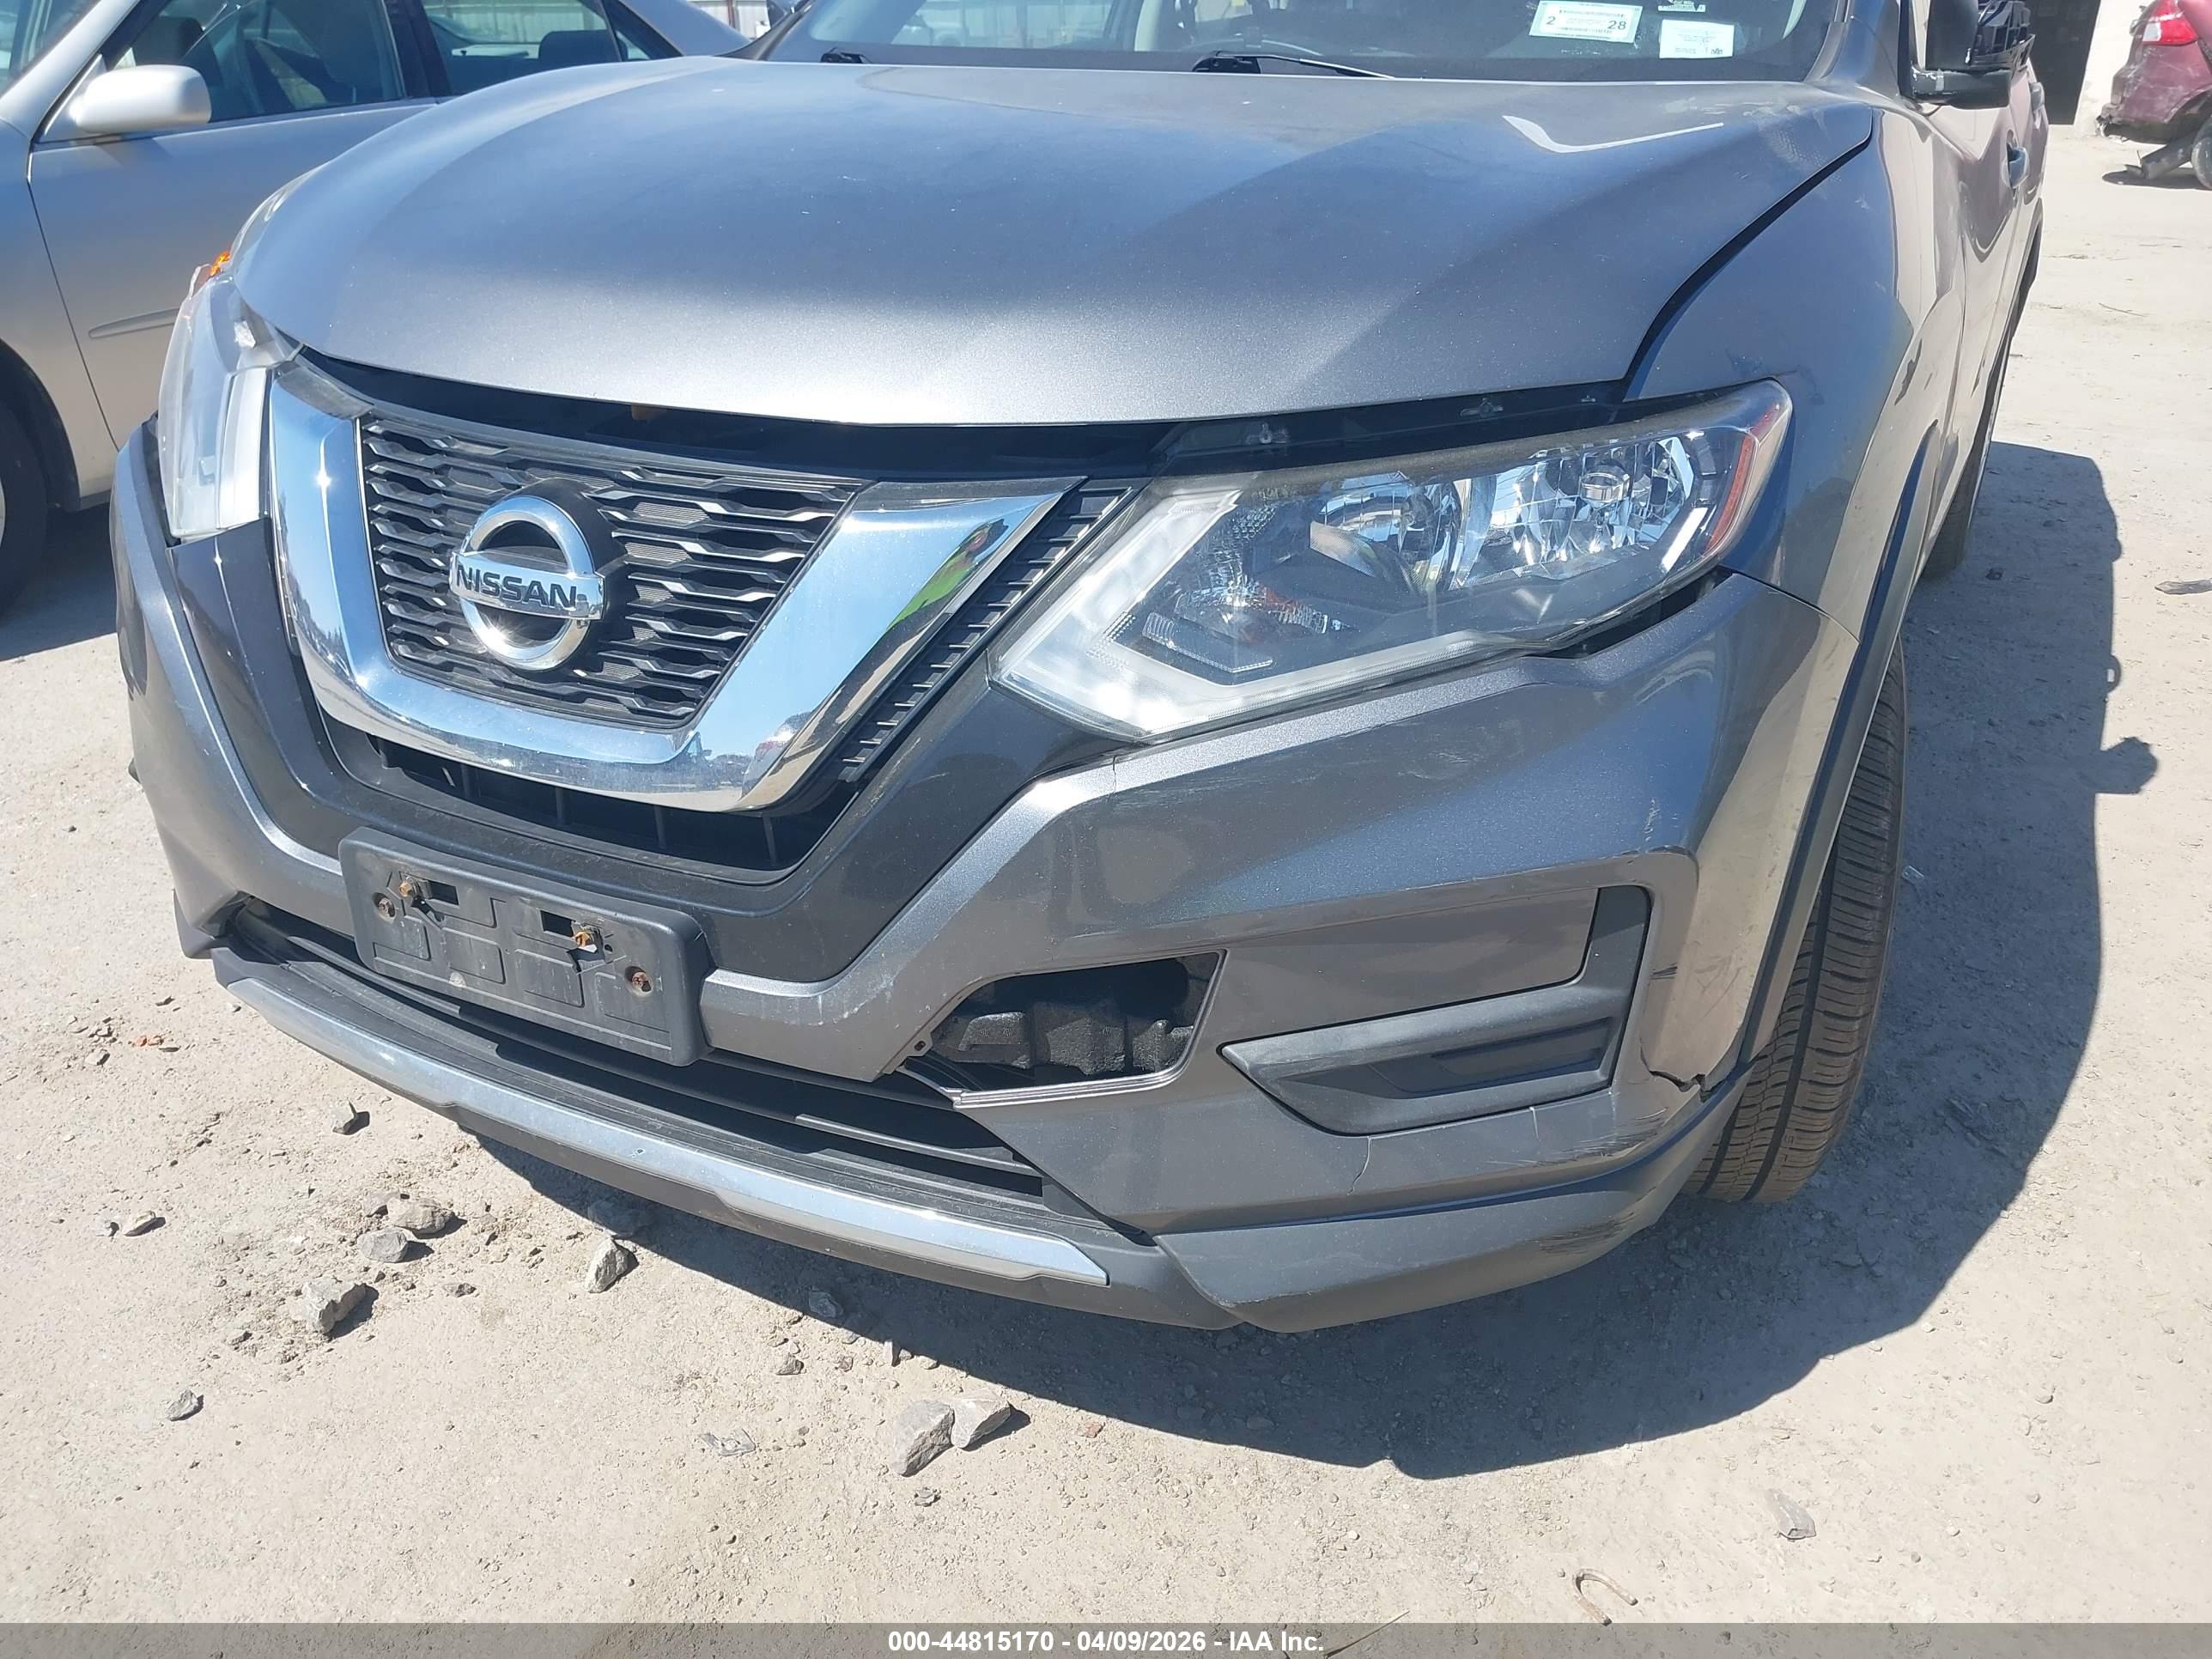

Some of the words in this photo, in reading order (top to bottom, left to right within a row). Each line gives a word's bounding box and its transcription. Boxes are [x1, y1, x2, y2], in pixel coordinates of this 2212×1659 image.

[1546, 15, 1556, 25] 2
[1607, 20, 1627, 30] 28
[457, 563, 577, 609] NISSAN
